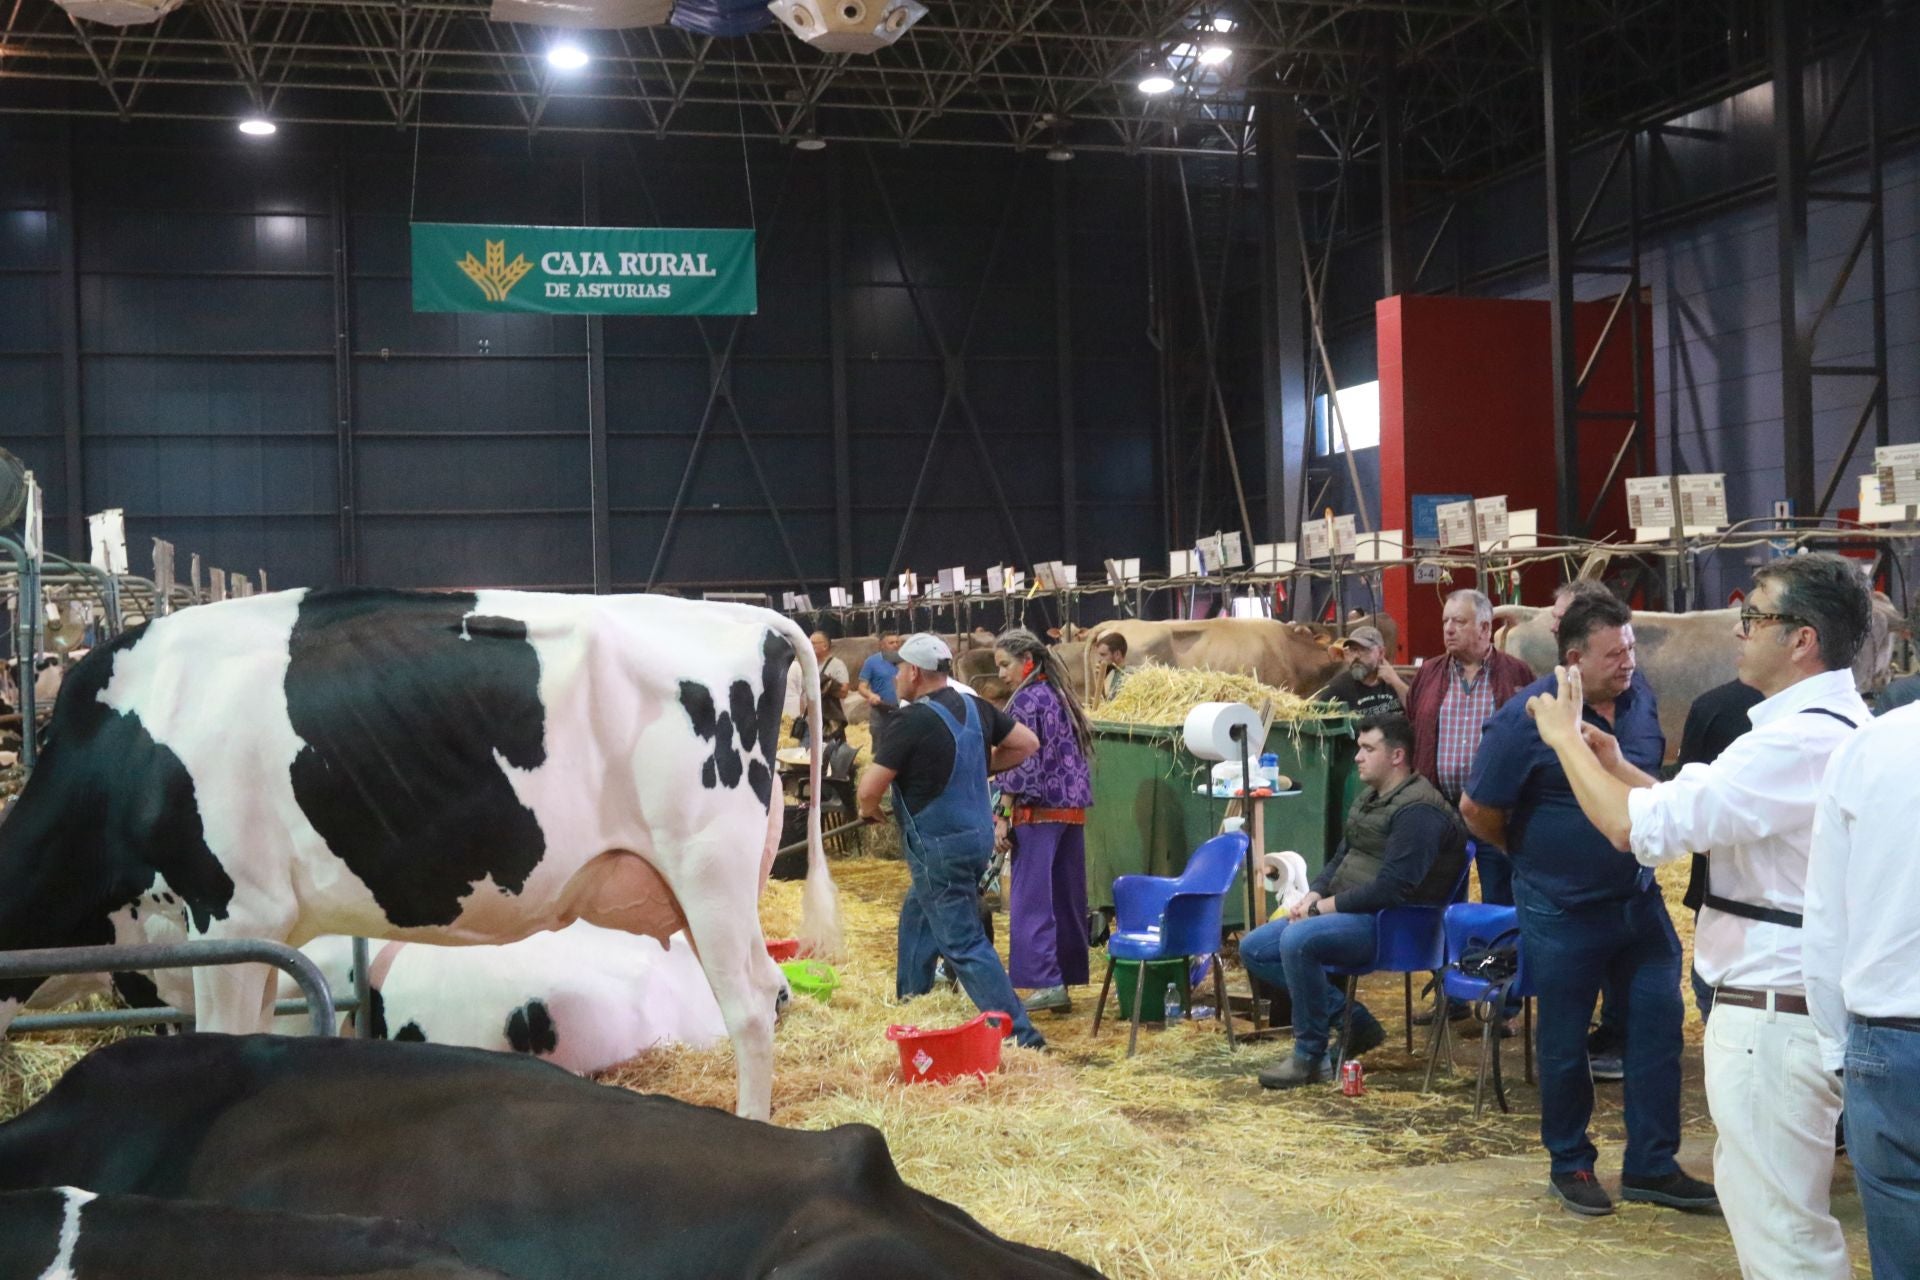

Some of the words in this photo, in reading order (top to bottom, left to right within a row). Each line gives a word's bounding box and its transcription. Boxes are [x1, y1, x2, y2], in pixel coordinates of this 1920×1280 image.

[541, 251, 612, 277] CAJA
[618, 252, 717, 277] RURAL
[545, 282, 571, 298] DE
[575, 283, 671, 298] ASTURIAS
[1417, 568, 1434, 579] 3-4
